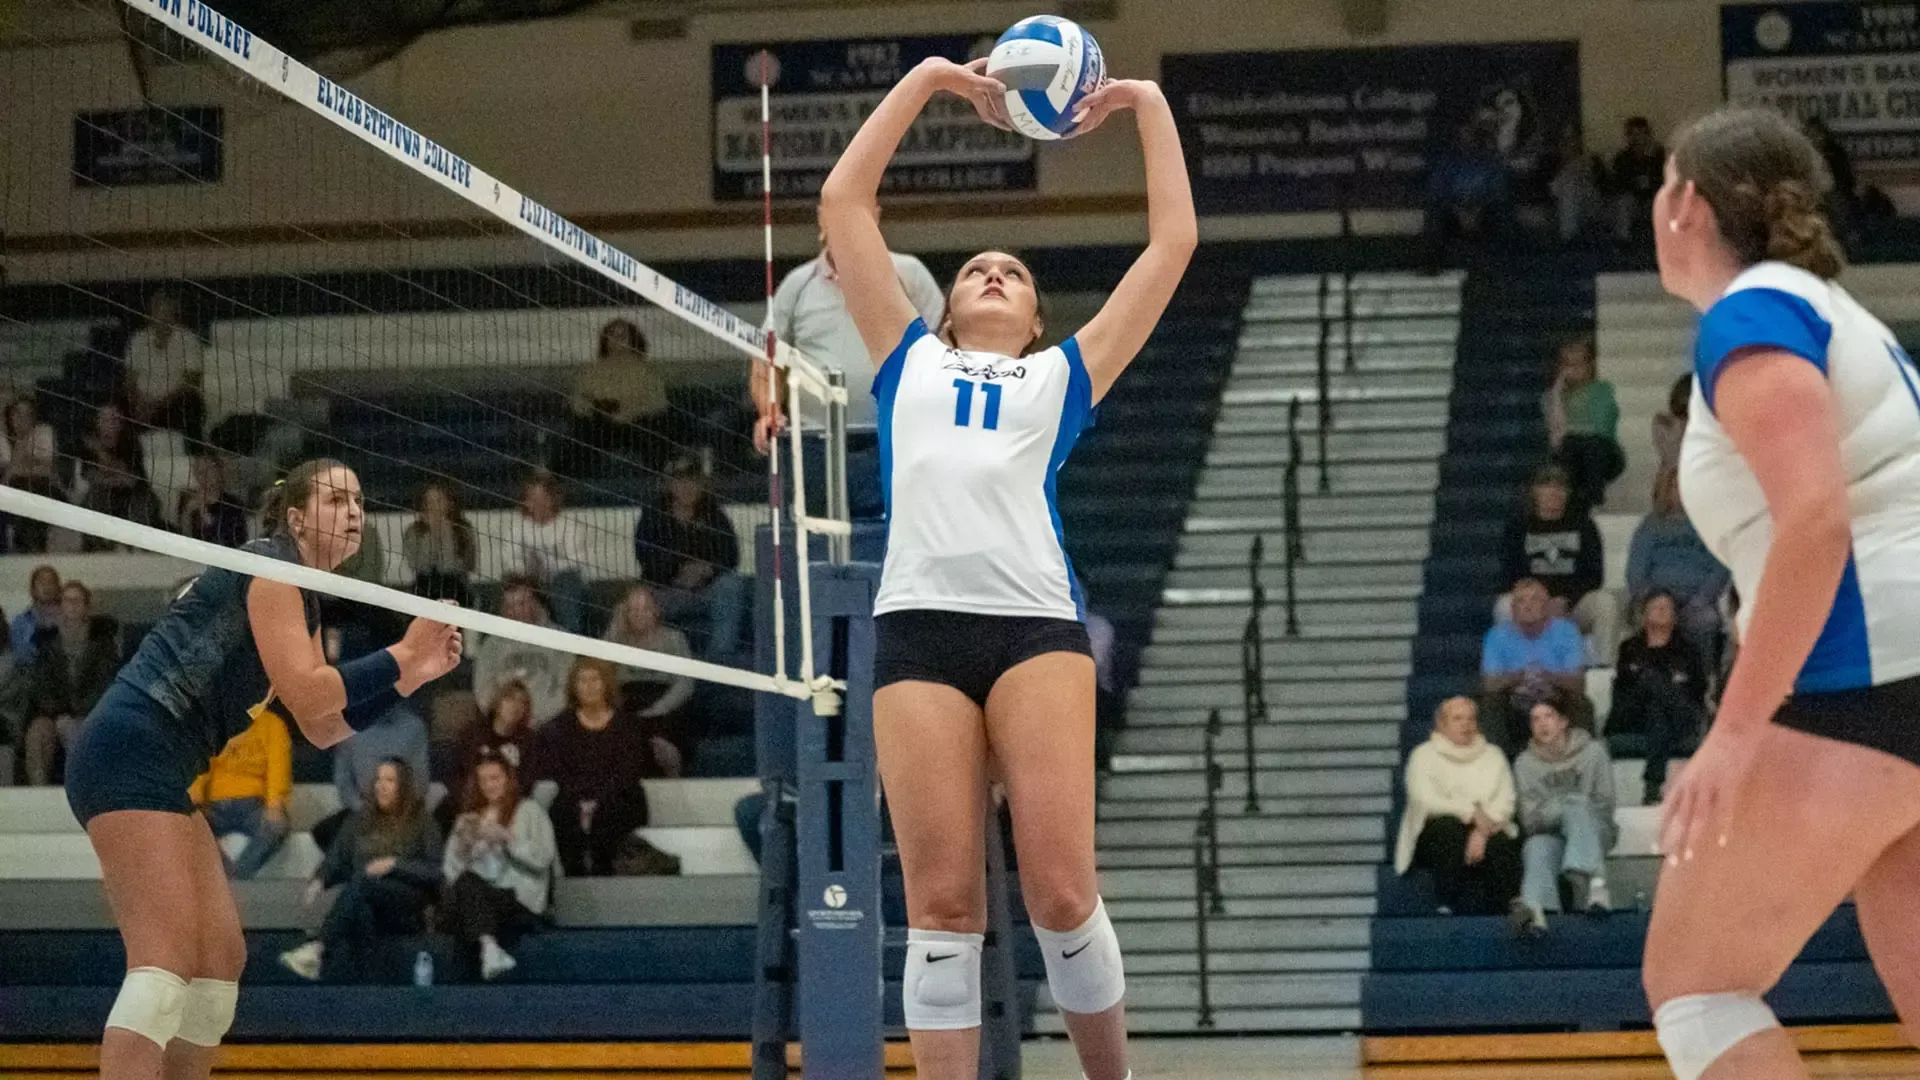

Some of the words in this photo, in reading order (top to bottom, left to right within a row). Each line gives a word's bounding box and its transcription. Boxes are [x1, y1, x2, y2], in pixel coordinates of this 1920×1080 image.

[187, 0, 251, 60] COLLEGE
[317, 76, 421, 160] ELIZABETHTOWN
[424, 138, 471, 188] COLLEGE
[952, 378, 1002, 431] 11
